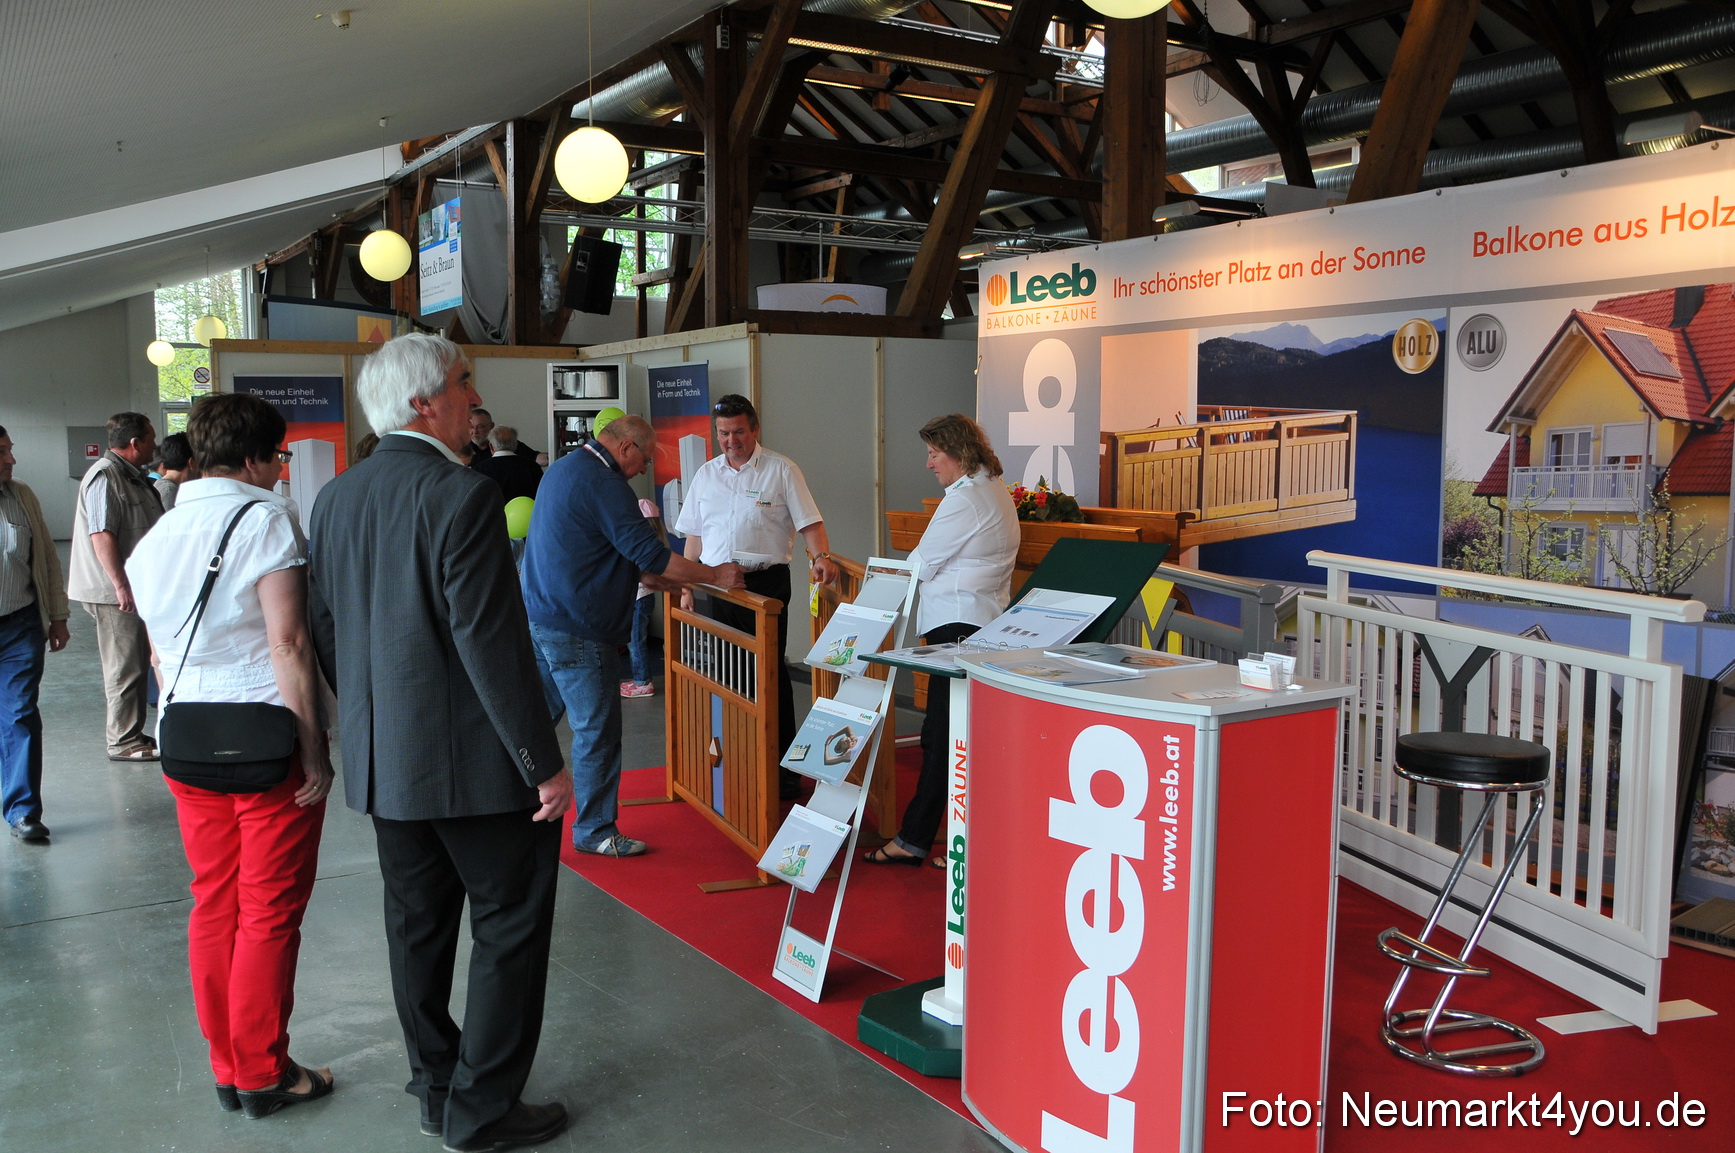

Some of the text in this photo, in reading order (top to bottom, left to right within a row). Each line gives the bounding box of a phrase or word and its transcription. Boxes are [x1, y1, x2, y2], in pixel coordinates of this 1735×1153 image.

[1472, 195, 1735, 258] Balkone aus Holz
[1010, 262, 1097, 304] Leeb
[1113, 246, 1426, 298] Ihr schönster Platz an der Sonne
[986, 306, 1097, 330] BALKONE ZÄUNE
[1398, 330, 1497, 357] HOLZ ALU
[249, 388, 264, 396] Die
[287, 388, 315, 396] Einheit
[656, 379, 693, 389] Die neue Einheit
[662, 390, 674, 398] Form
[674, 389, 683, 397] und
[684, 388, 701, 397] Technik
[299, 397, 329, 405] Technik
[1159, 734, 1181, 892] www.leeb.at
[948, 738, 967, 936] Leeb ZÄUNE
[1041, 724, 1149, 1153] Leeb
[792, 945, 816, 969] Leeb
